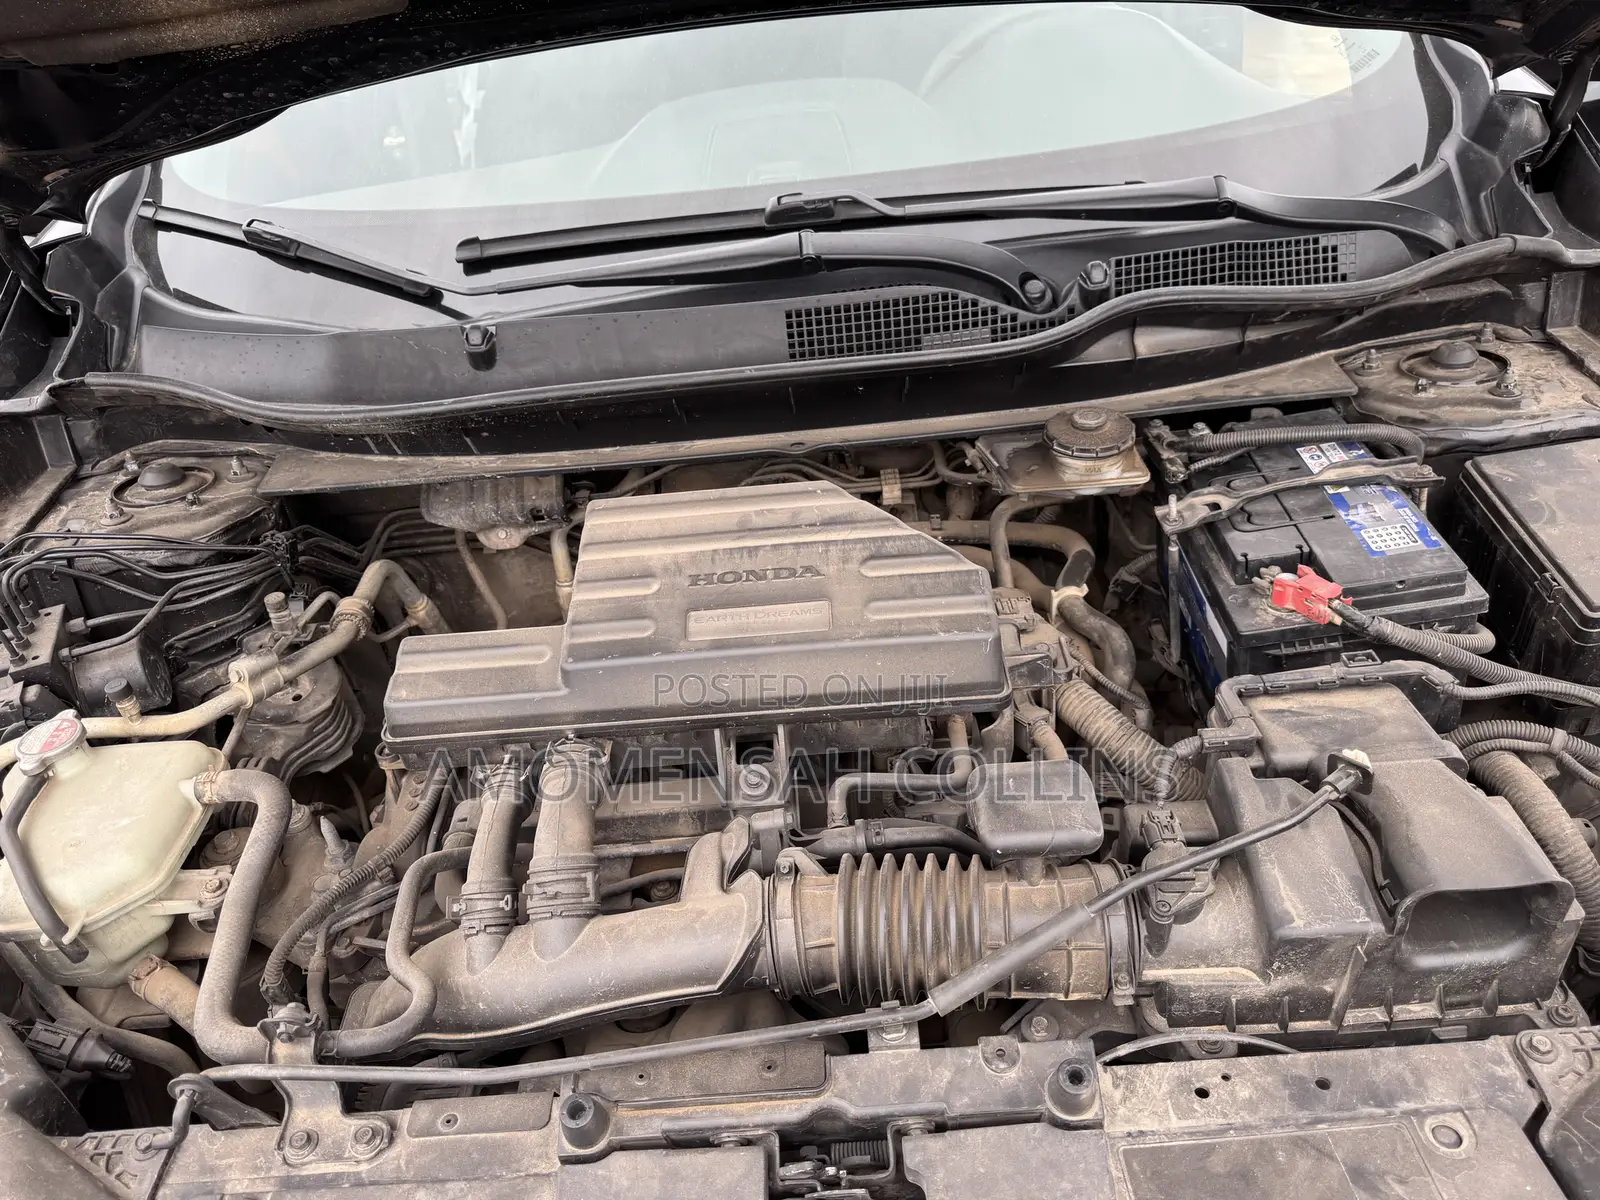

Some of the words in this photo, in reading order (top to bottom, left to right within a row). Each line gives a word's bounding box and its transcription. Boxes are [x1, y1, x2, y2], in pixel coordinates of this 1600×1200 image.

[688, 565, 825, 587] HONDA
[694, 611, 750, 624] EARTH
[755, 607, 823, 619] DREAMS
